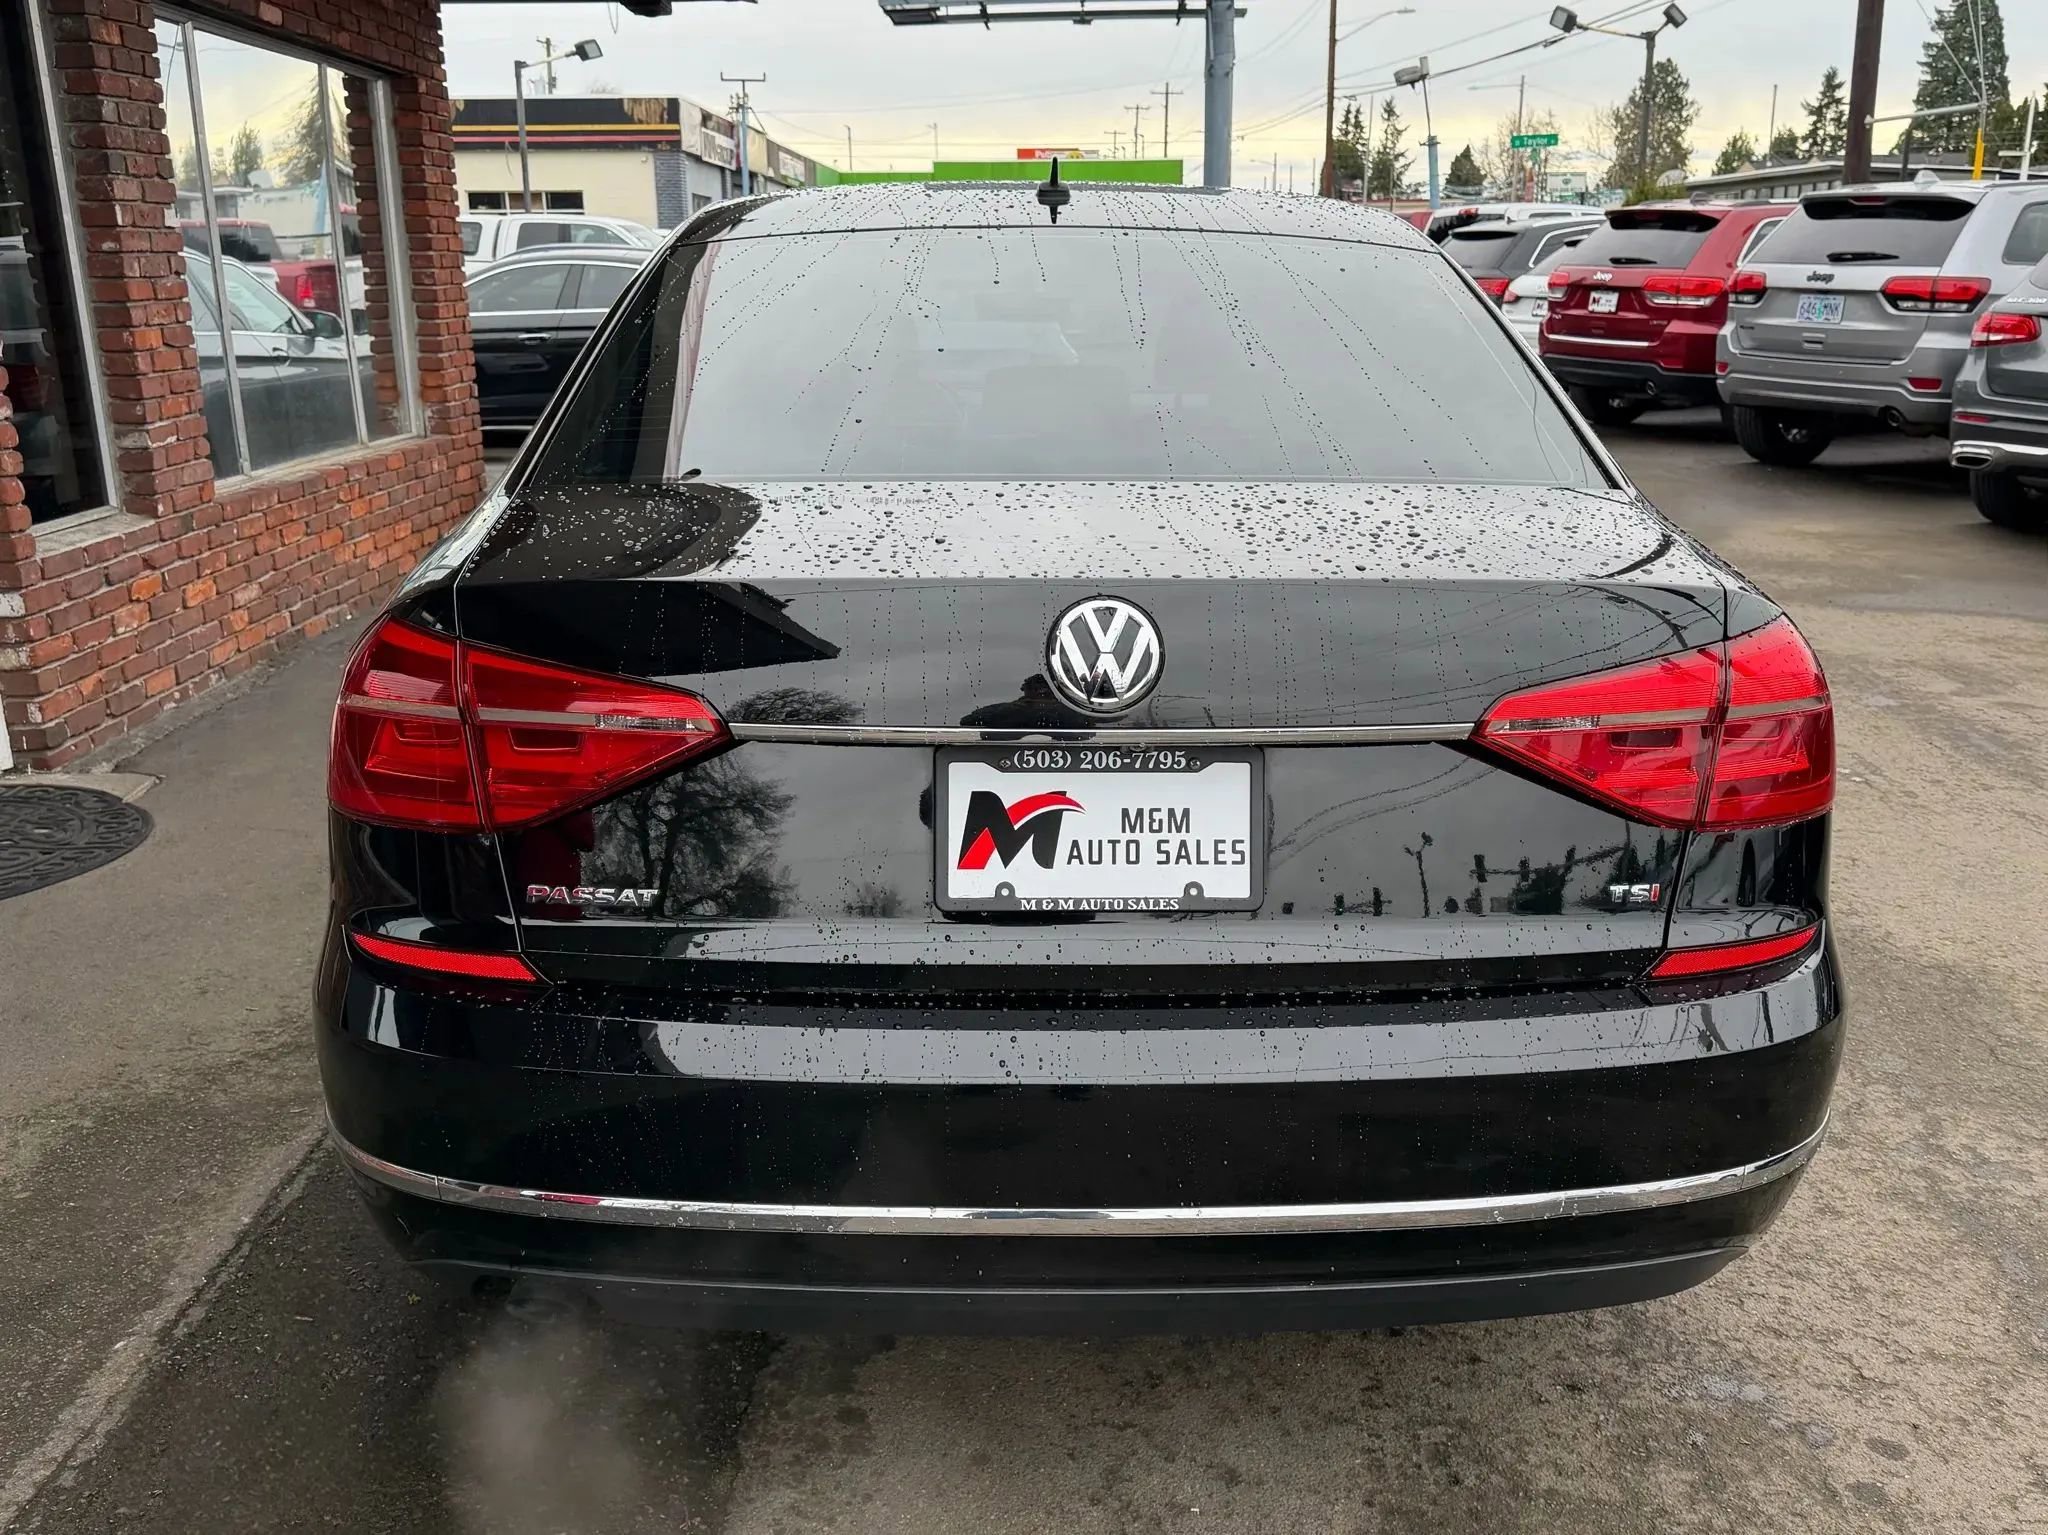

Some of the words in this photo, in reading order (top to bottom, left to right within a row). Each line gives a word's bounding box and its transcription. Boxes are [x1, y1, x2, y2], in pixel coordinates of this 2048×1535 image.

[1523, 136, 1548, 148] Taylor
[1593, 271, 1613, 281] Jeep
[1806, 270, 1835, 285] Jeep
[1013, 750, 1072, 769] (503)
[1080, 750, 1187, 770] 206-7795
[1121, 807, 1191, 834] M&M
[1066, 838, 1140, 866] AUTO
[1156, 838, 1246, 866] SALES
[526, 885, 660, 907] PASSAT
[1609, 883, 1660, 903] TSI
[1021, 898, 1037, 911] M
[1042, 899, 1055, 911] &
[1058, 898, 1075, 911] M
[1079, 898, 1124, 911] AUTO
[1127, 898, 1180, 911] SALES
